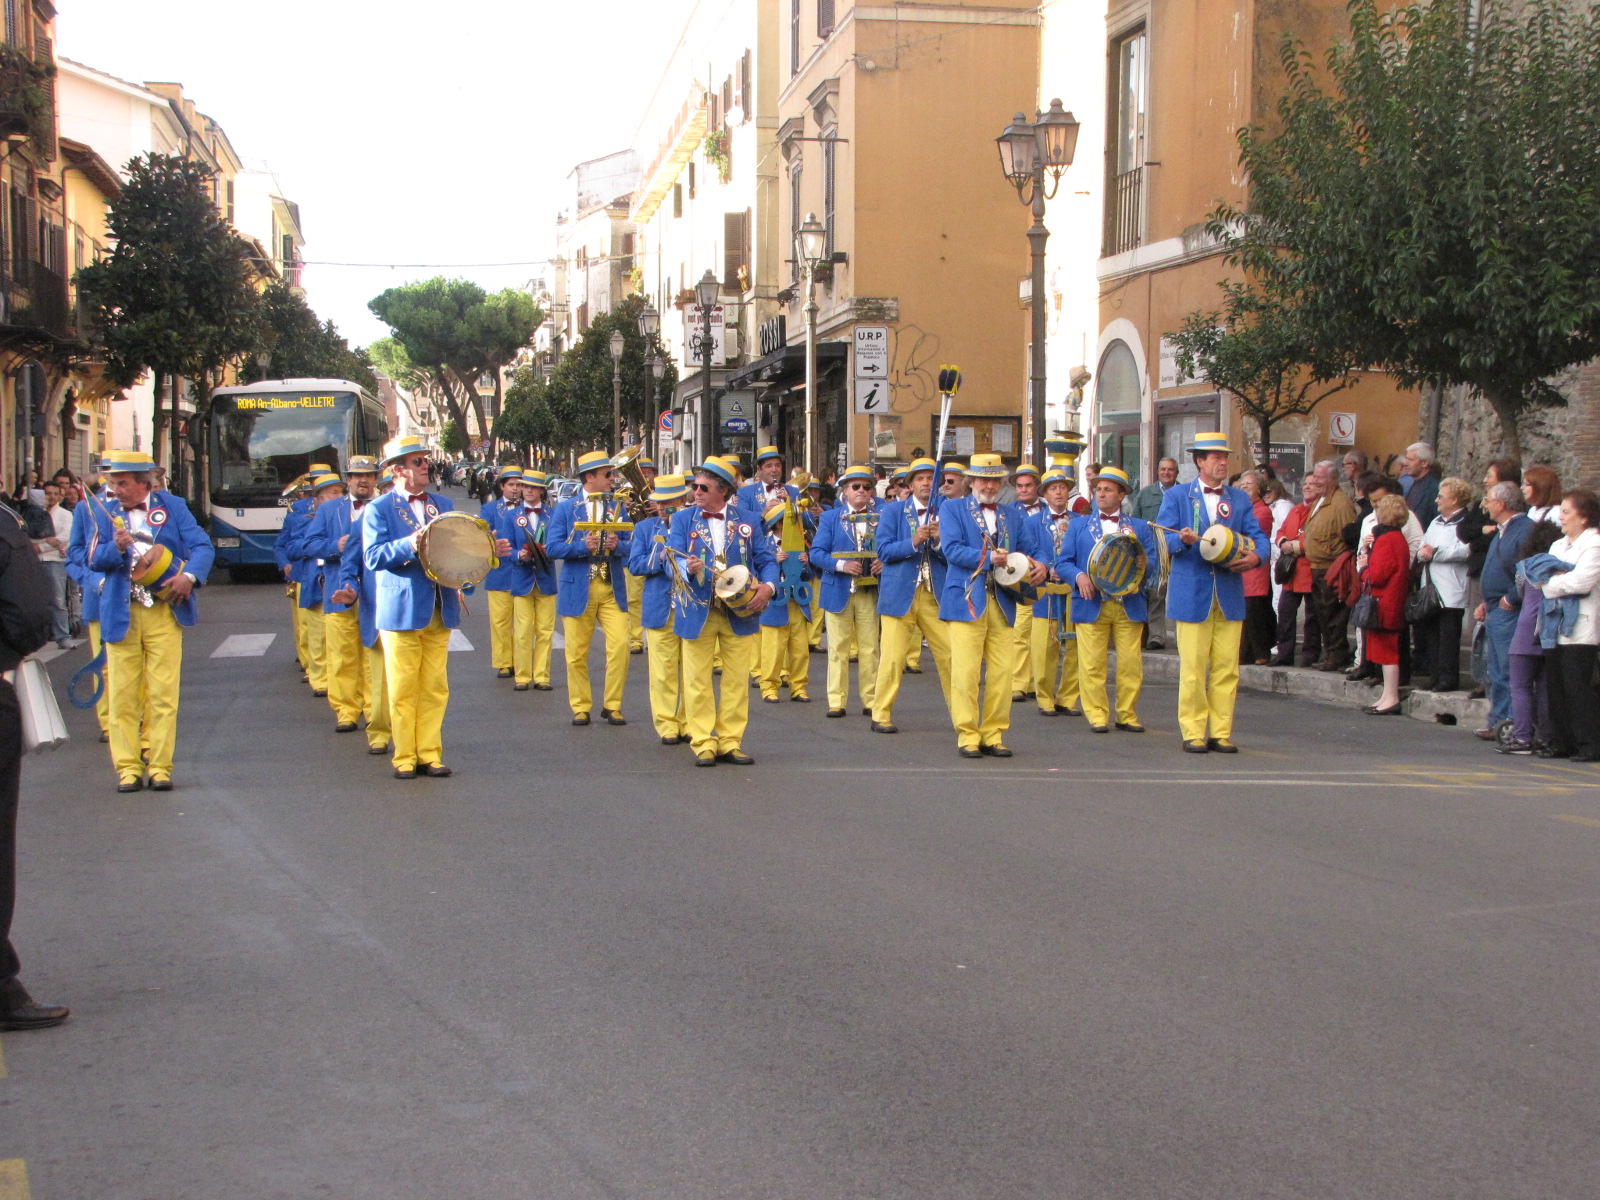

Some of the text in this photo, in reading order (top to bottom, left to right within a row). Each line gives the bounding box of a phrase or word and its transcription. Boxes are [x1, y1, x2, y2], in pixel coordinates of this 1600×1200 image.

[688, 314, 696, 323] not
[758, 315, 780, 356] ROSSI
[858, 332, 885, 341] U.R.P.
[237, 398, 256, 409] ROMA
